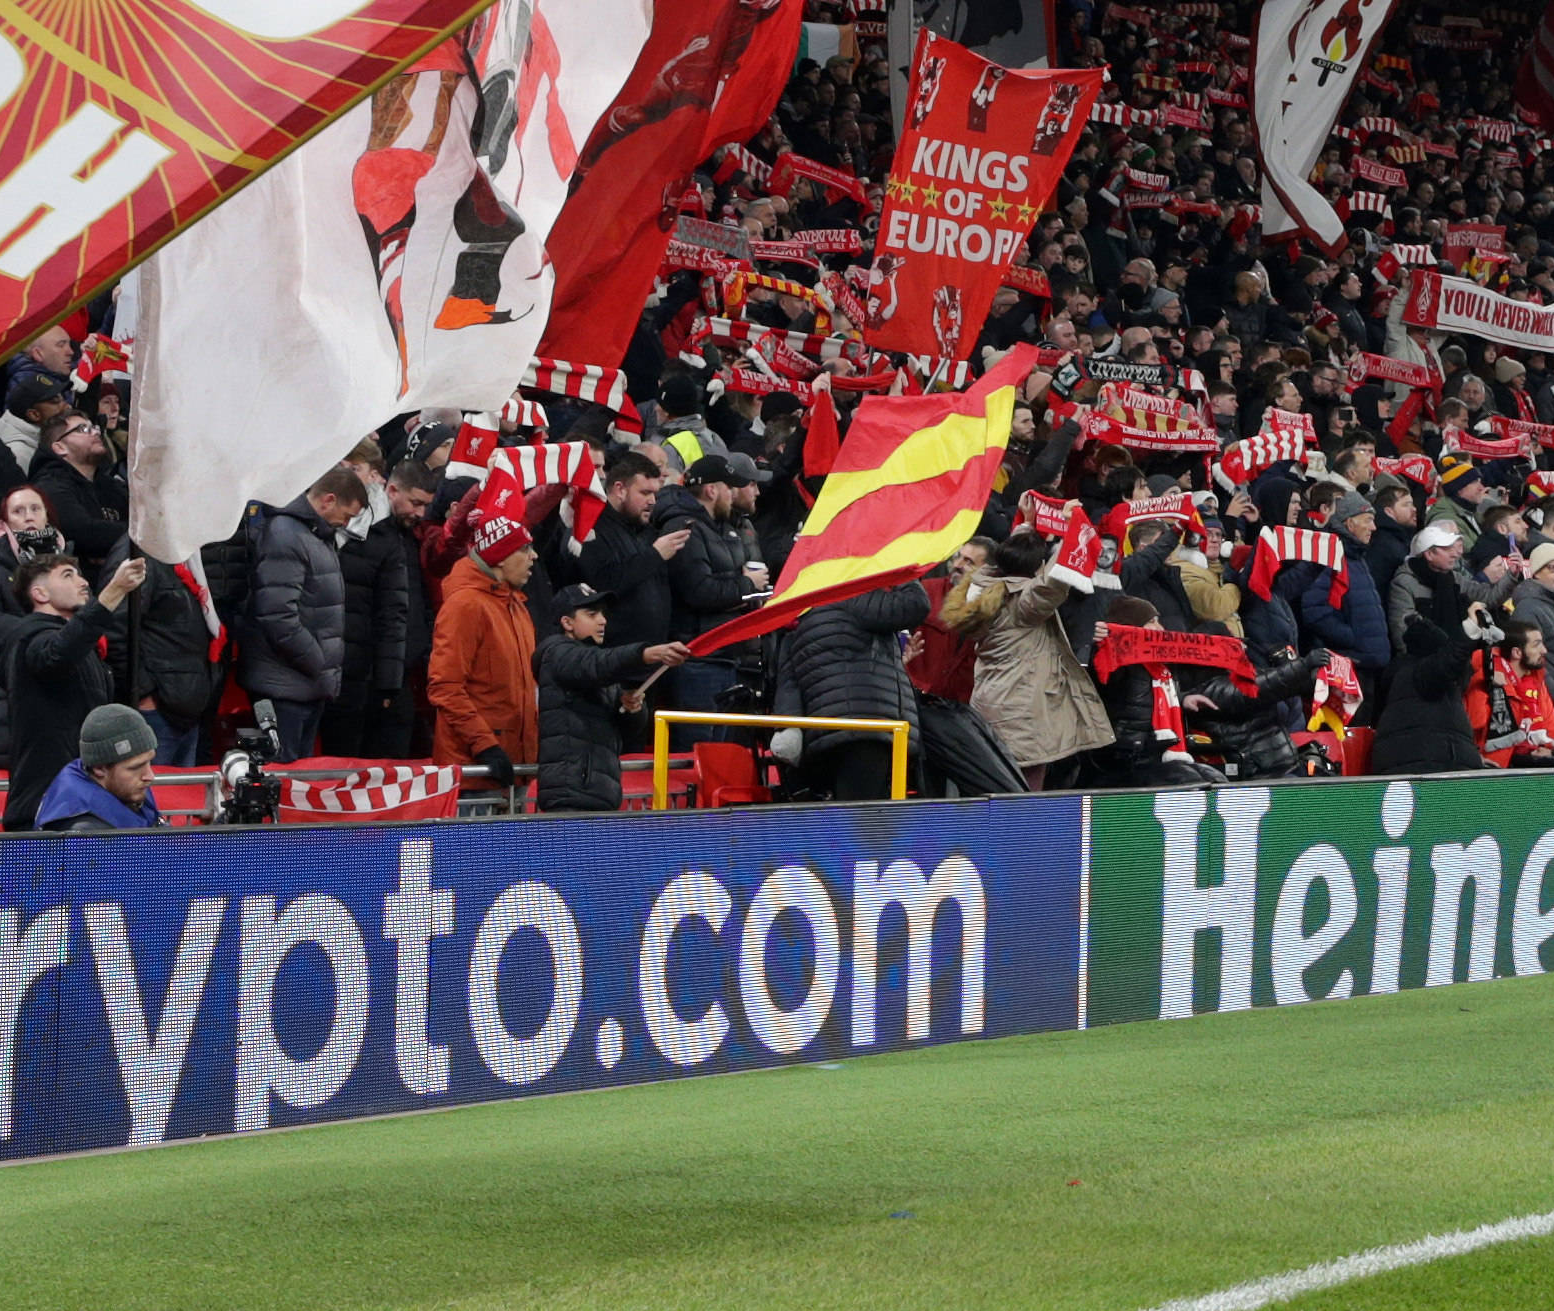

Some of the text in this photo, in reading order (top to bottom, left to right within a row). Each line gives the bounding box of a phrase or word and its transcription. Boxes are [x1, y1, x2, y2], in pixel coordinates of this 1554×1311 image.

[911, 136, 1029, 193] KINGS
[943, 188, 983, 218] OF
[1492, 299, 1530, 334] NEVER
[1088, 359, 1163, 383] LIVERPOOL
[1125, 389, 1166, 412] LIVERPOOL
